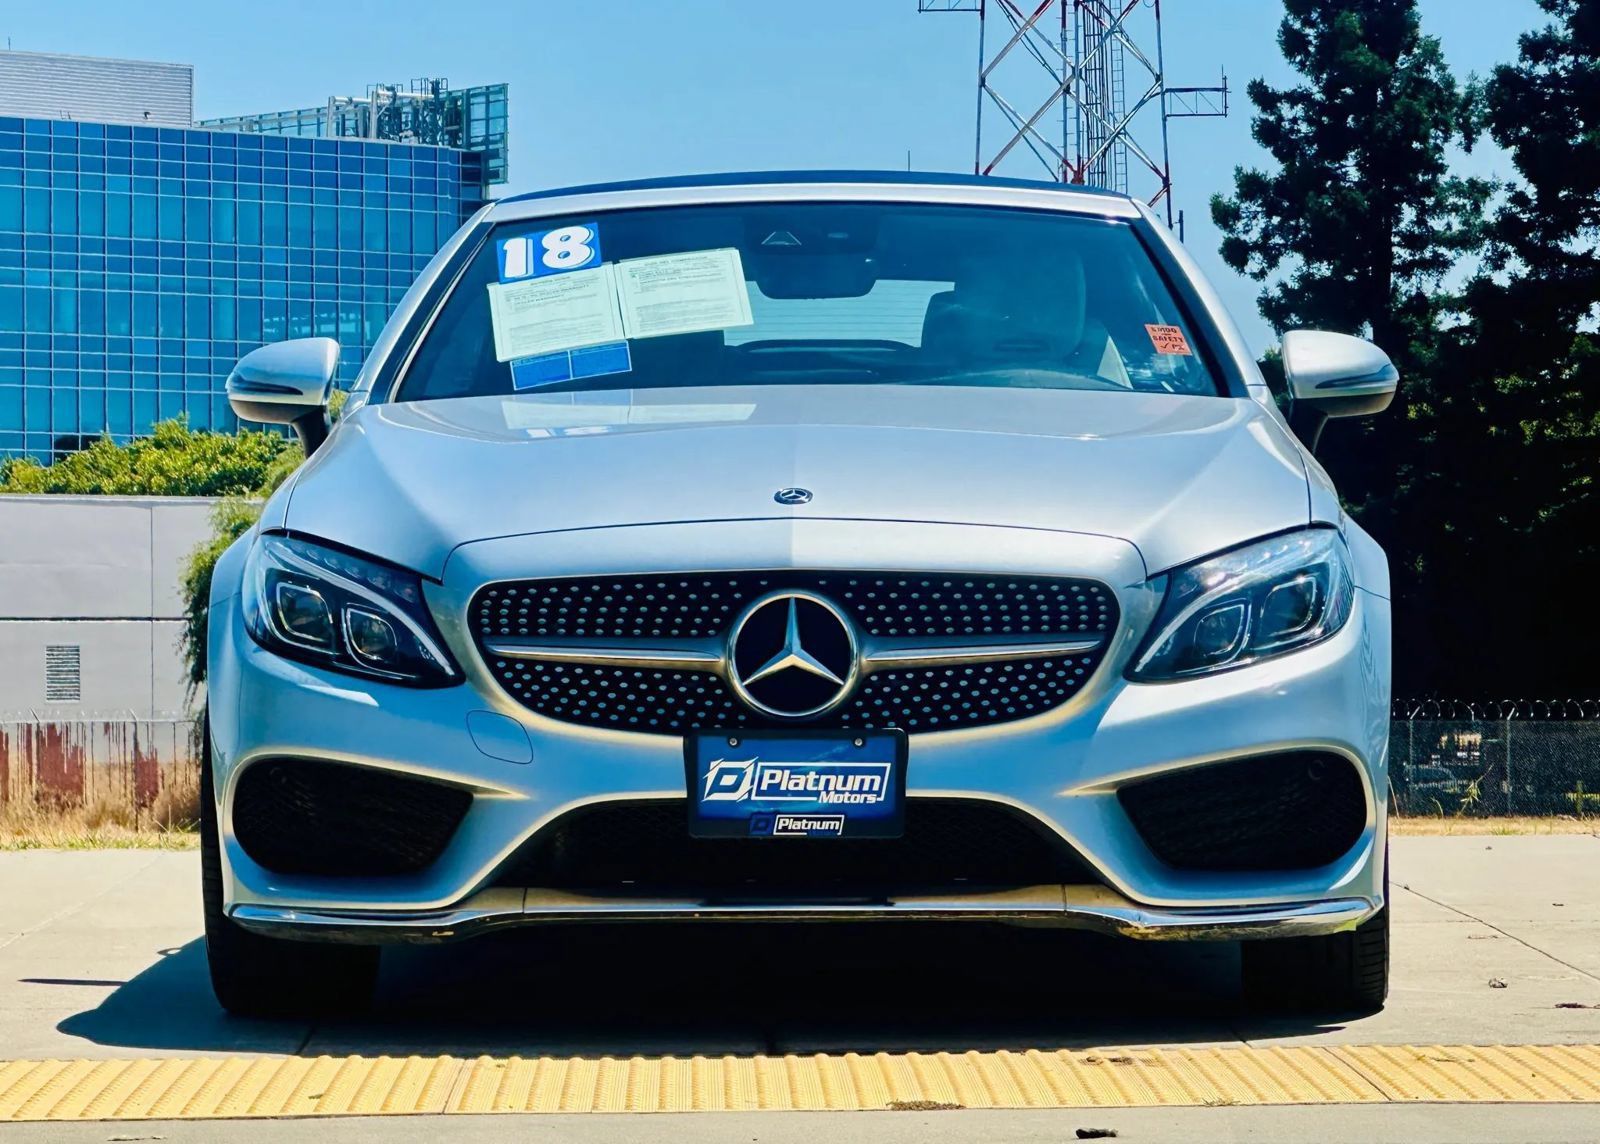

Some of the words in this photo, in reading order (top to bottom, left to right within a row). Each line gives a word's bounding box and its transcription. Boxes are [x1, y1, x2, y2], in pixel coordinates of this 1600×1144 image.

[503, 226, 595, 278] 18
[1152, 335, 1184, 343] SAFETY
[760, 769, 881, 791] Platnum
[818, 791, 877, 804] Motors
[777, 818, 840, 830] Platnum
